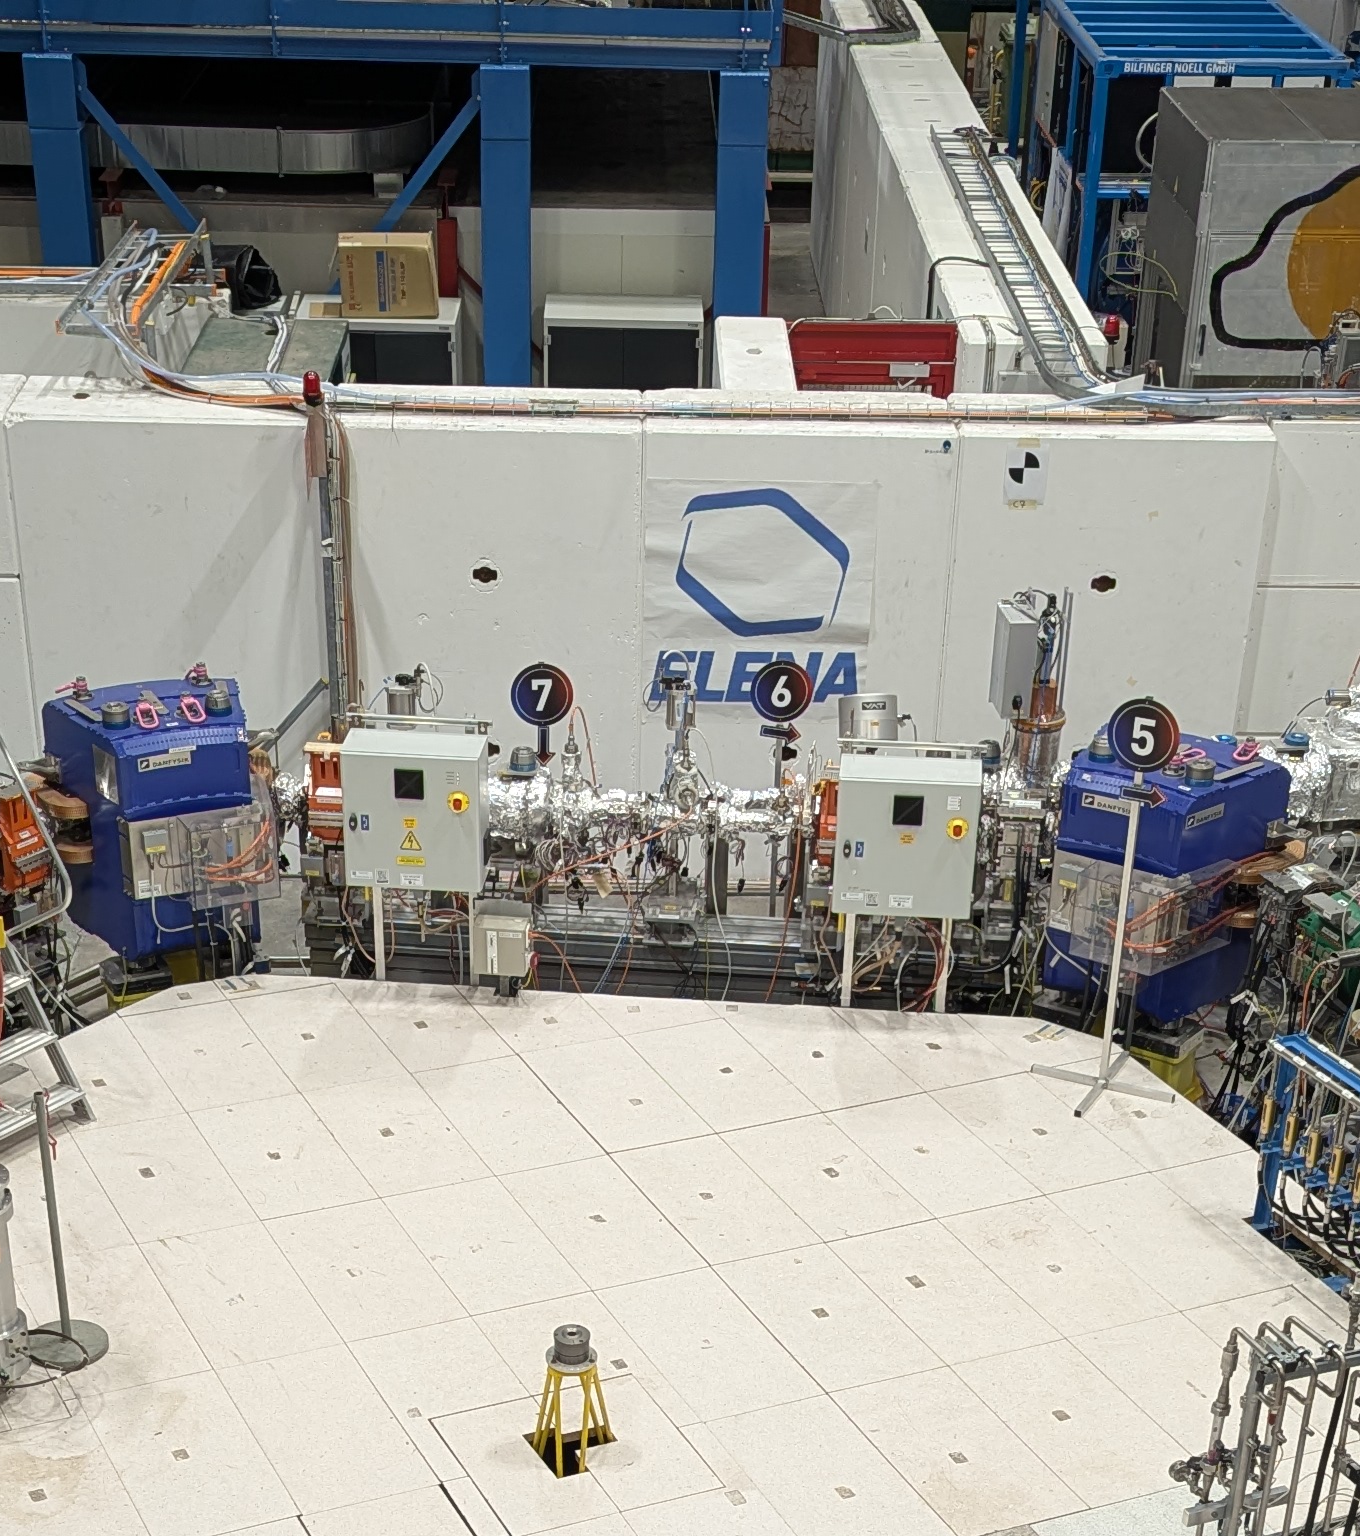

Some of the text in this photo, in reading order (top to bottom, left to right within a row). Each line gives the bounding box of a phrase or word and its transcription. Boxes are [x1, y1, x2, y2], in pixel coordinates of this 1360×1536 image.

[1124, 62, 1236, 74] BILFINGER NOELL GMBH
[532, 679, 552, 711] 7
[771, 676, 792, 707] 6
[1131, 717, 1156, 756] 5
[152, 757, 190, 768] DANFYSIK
